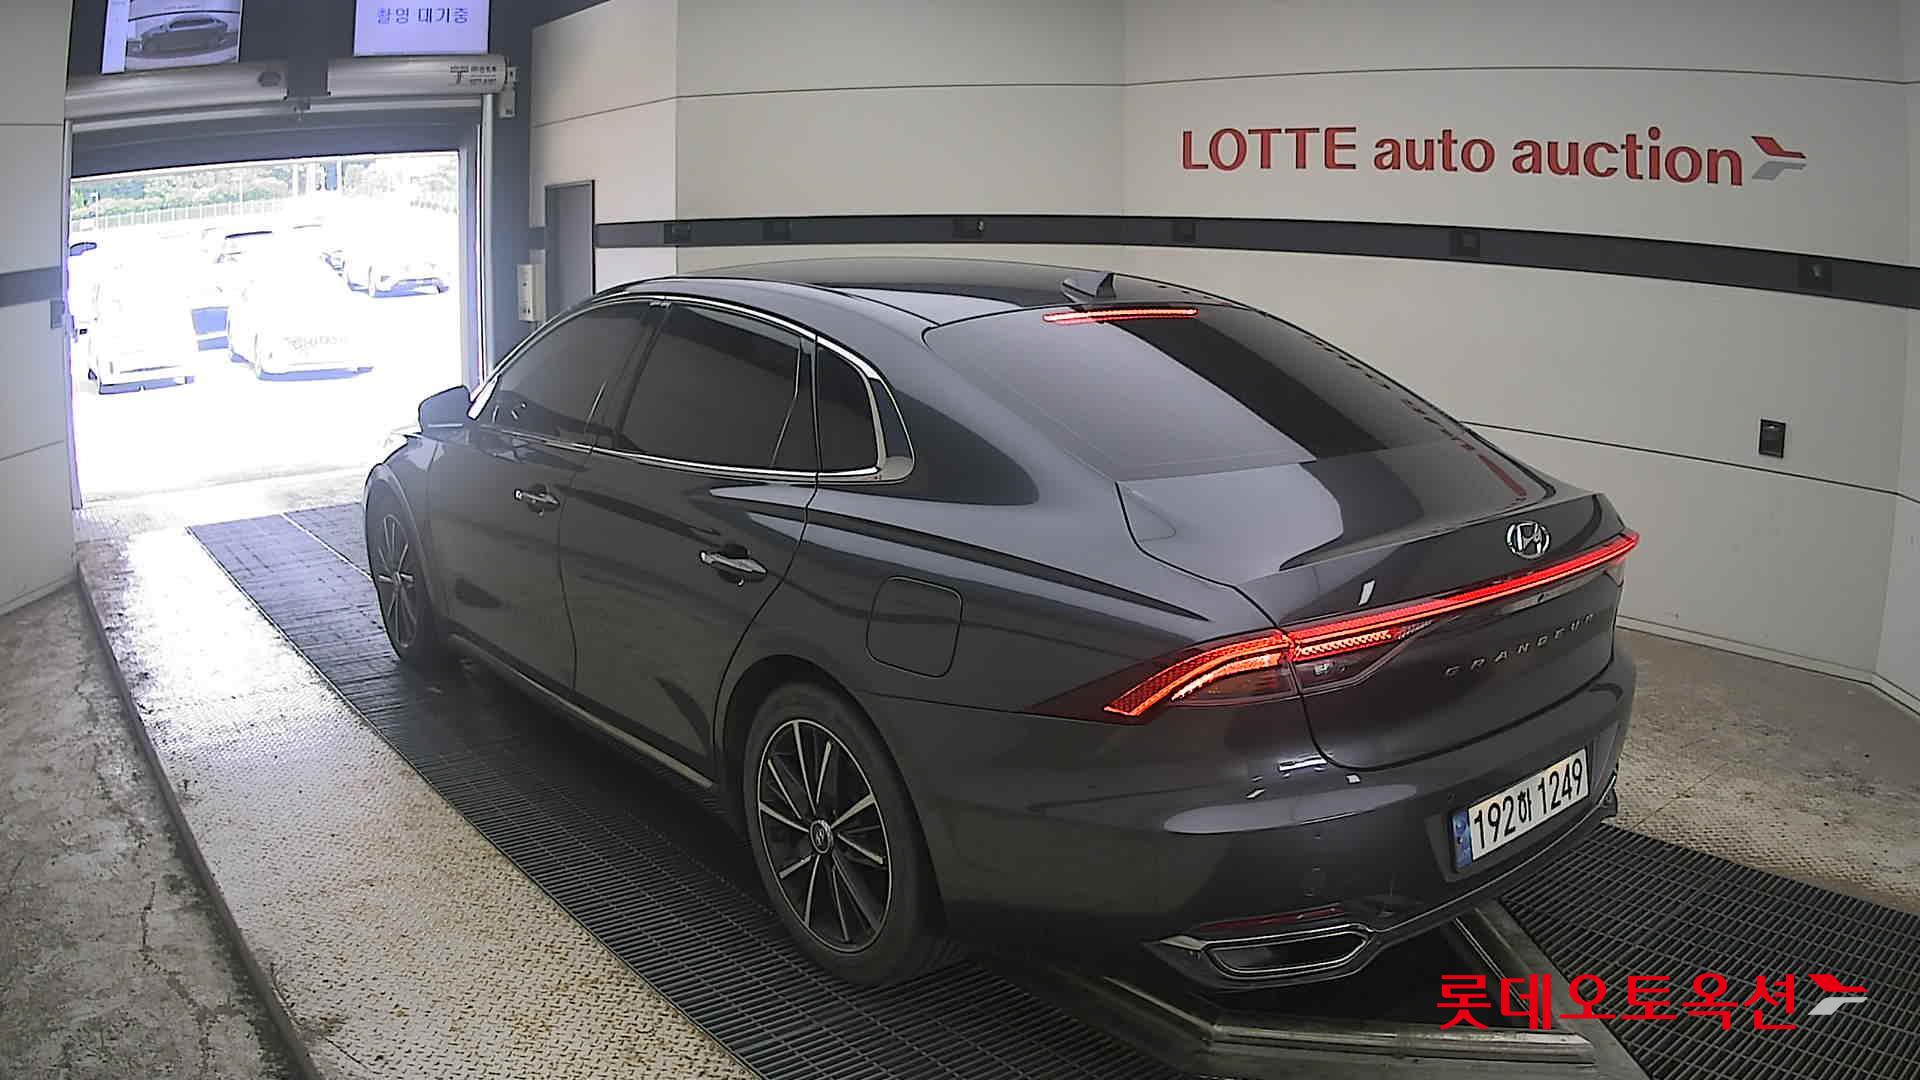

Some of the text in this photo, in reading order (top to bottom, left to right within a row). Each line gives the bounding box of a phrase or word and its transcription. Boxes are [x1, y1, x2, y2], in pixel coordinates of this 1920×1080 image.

[417, 7, 469, 24] 대기중
[1181, 126, 1744, 187] LOTTE auto auction
[1537, 757, 1584, 815] 1249
